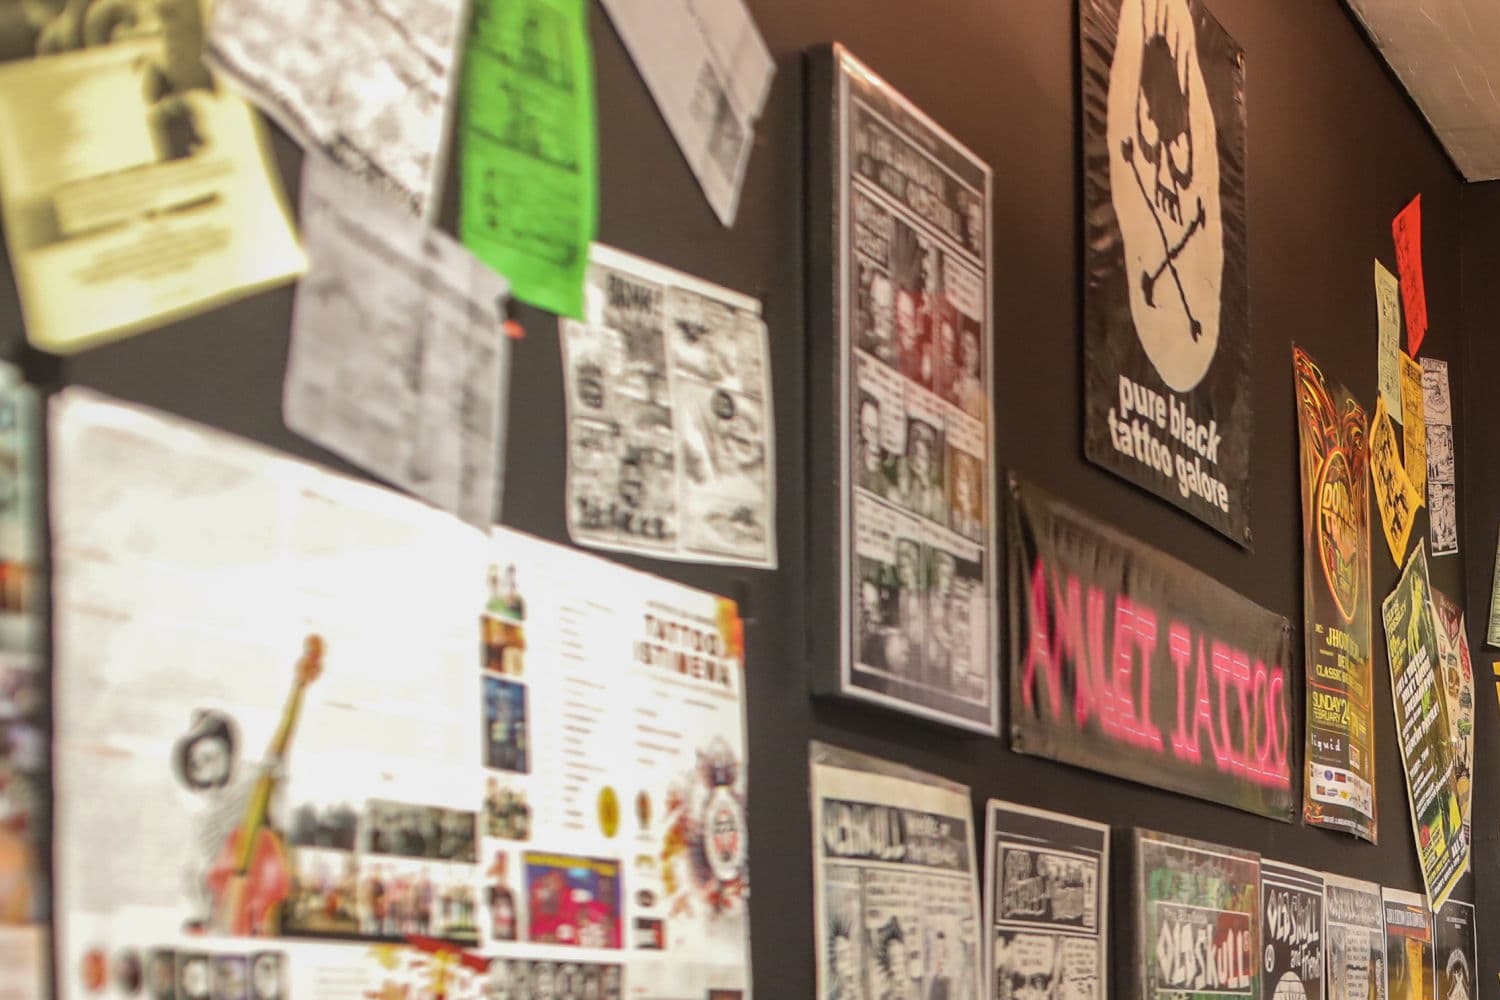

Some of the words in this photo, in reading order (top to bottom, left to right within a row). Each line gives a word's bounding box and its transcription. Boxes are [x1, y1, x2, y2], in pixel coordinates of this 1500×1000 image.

[1118, 373, 1167, 429] pure
[1169, 394, 1221, 464] black
[1108, 407, 1174, 478] tattoo
[1175, 453, 1230, 513] galore
[1312, 691, 1341, 713] SUNDAY
[1266, 888, 1320, 946] OLDSKULL
[1156, 919, 1251, 990] OLDSKULL
